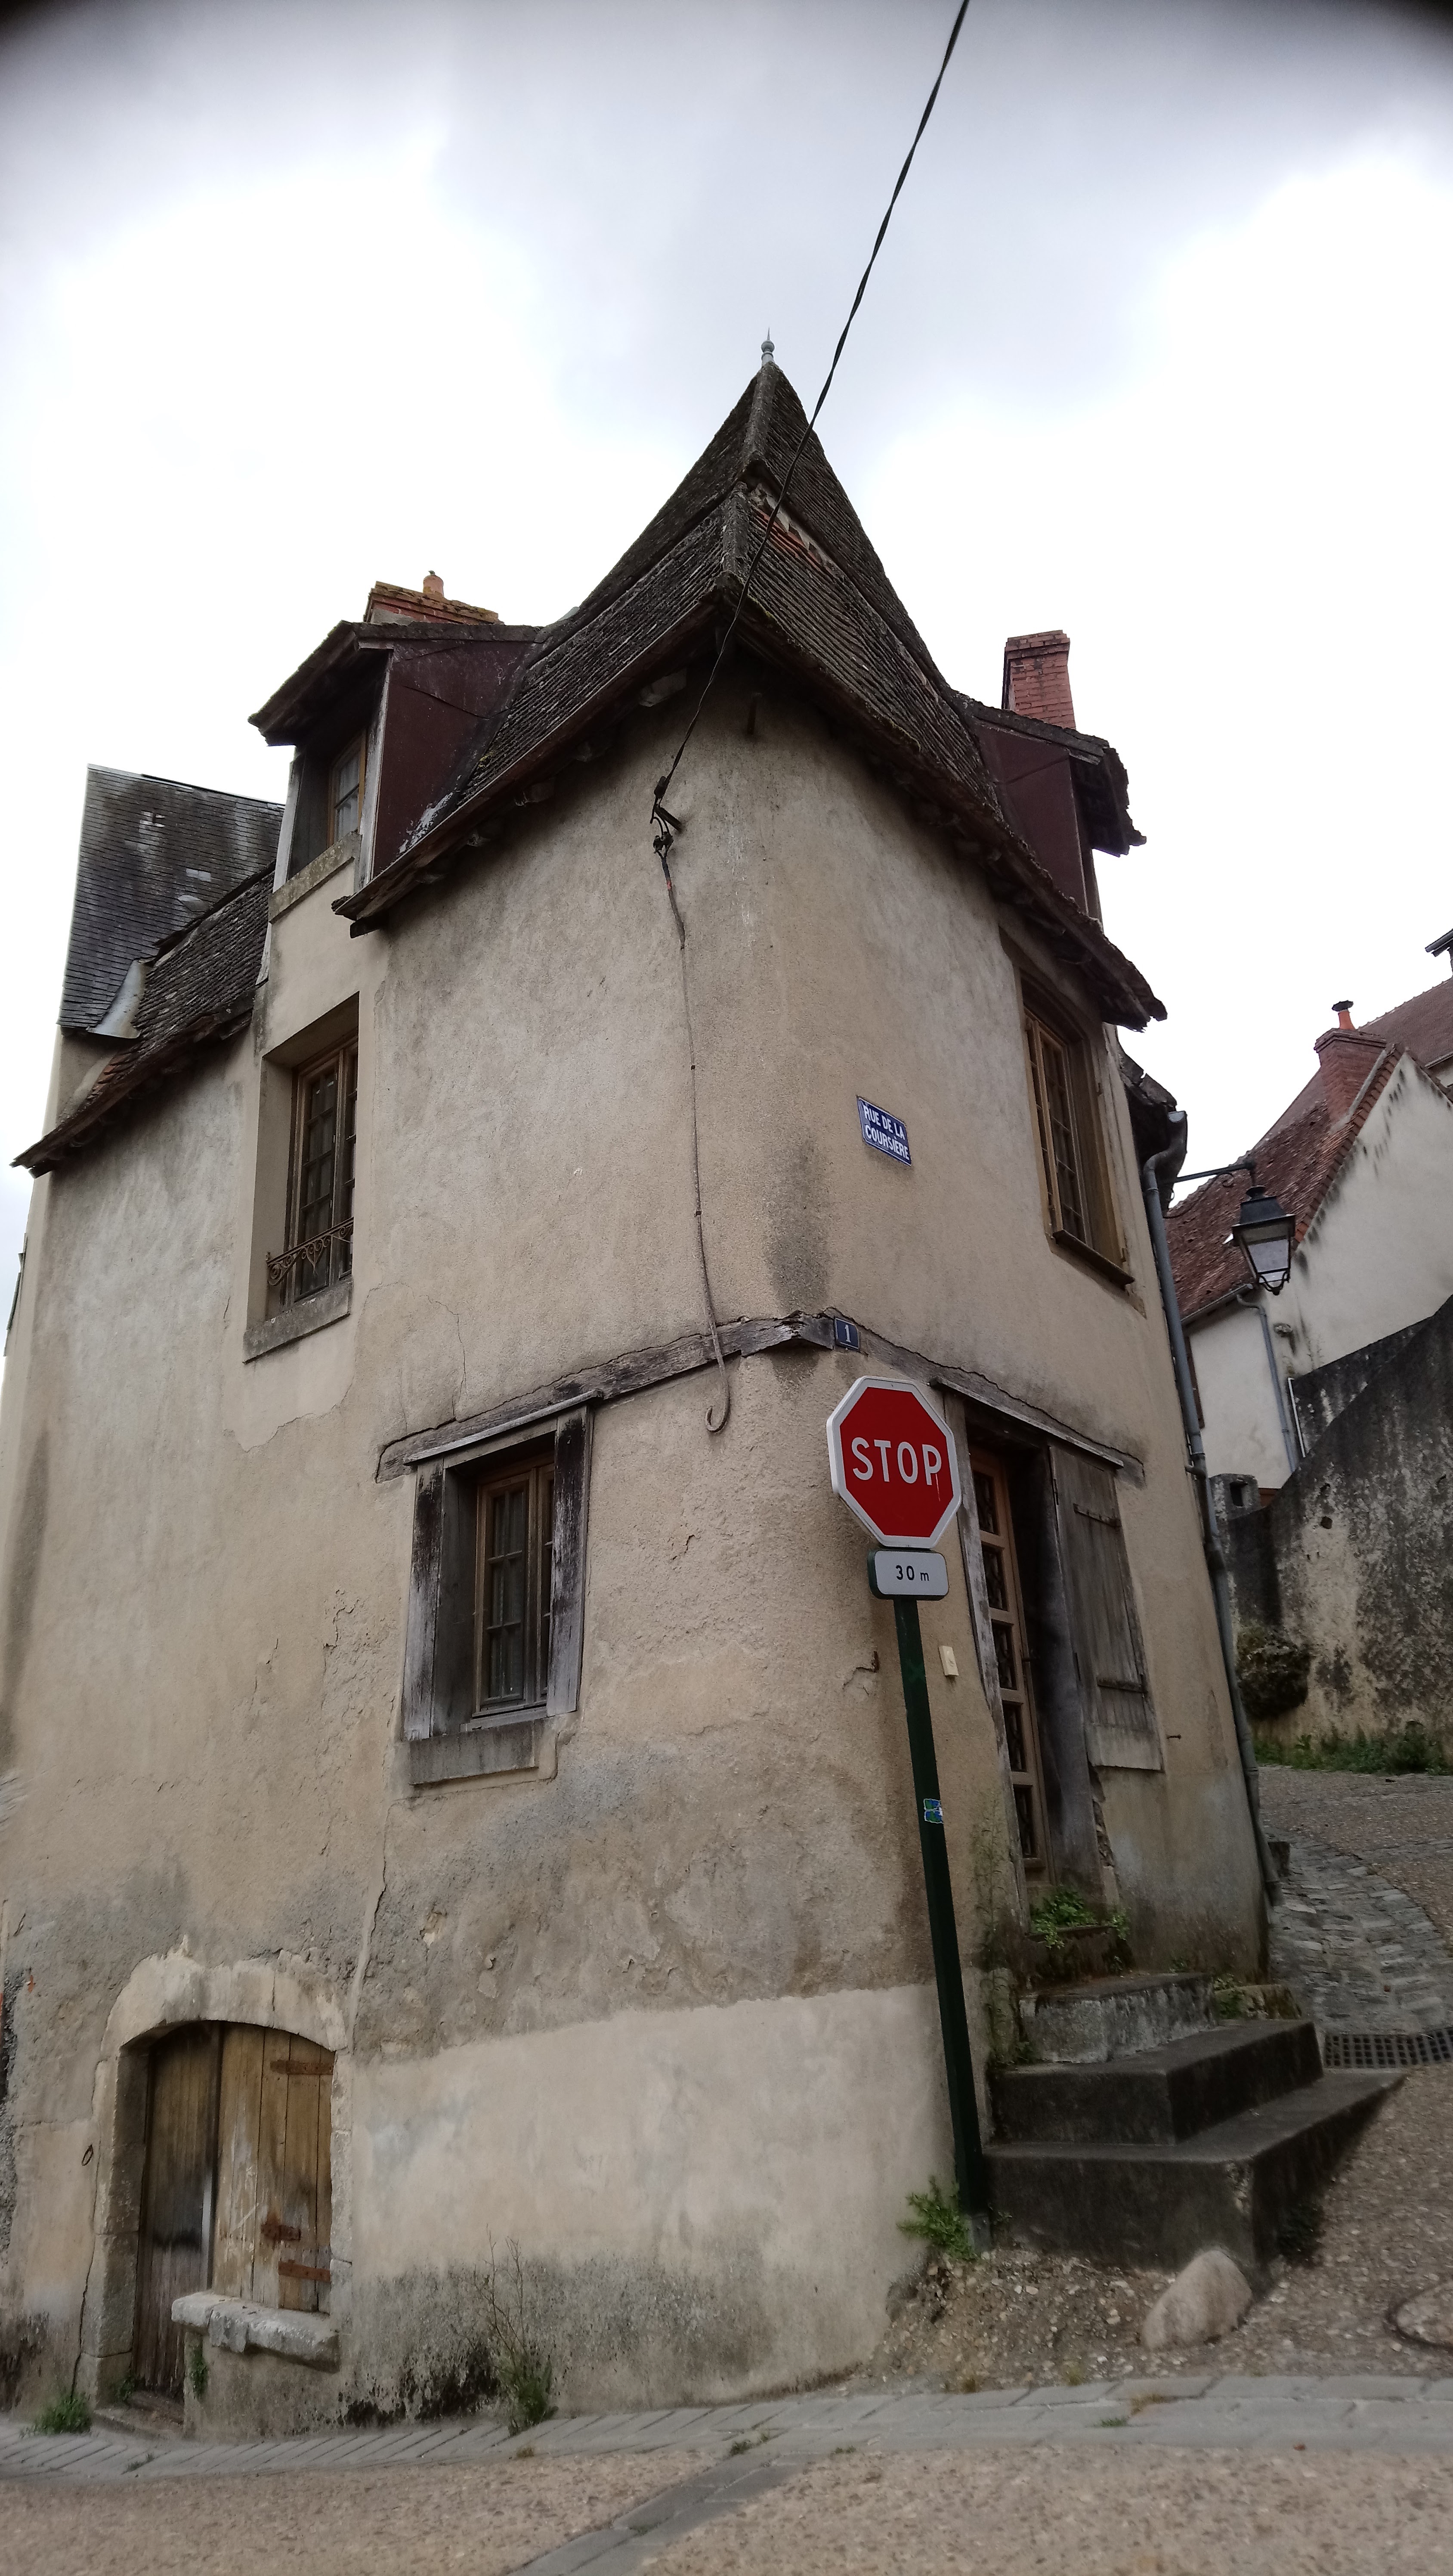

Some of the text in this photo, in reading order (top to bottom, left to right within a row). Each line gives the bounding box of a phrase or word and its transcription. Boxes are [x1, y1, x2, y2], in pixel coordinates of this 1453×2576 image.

[863, 1105, 905, 1140] RUE DE LA
[865, 1124, 909, 1161] COURSIÈRE
[844, 1324, 851, 1343] 1
[851, 1437, 942, 1486] STOP
[896, 1565, 930, 1581] 30 m
